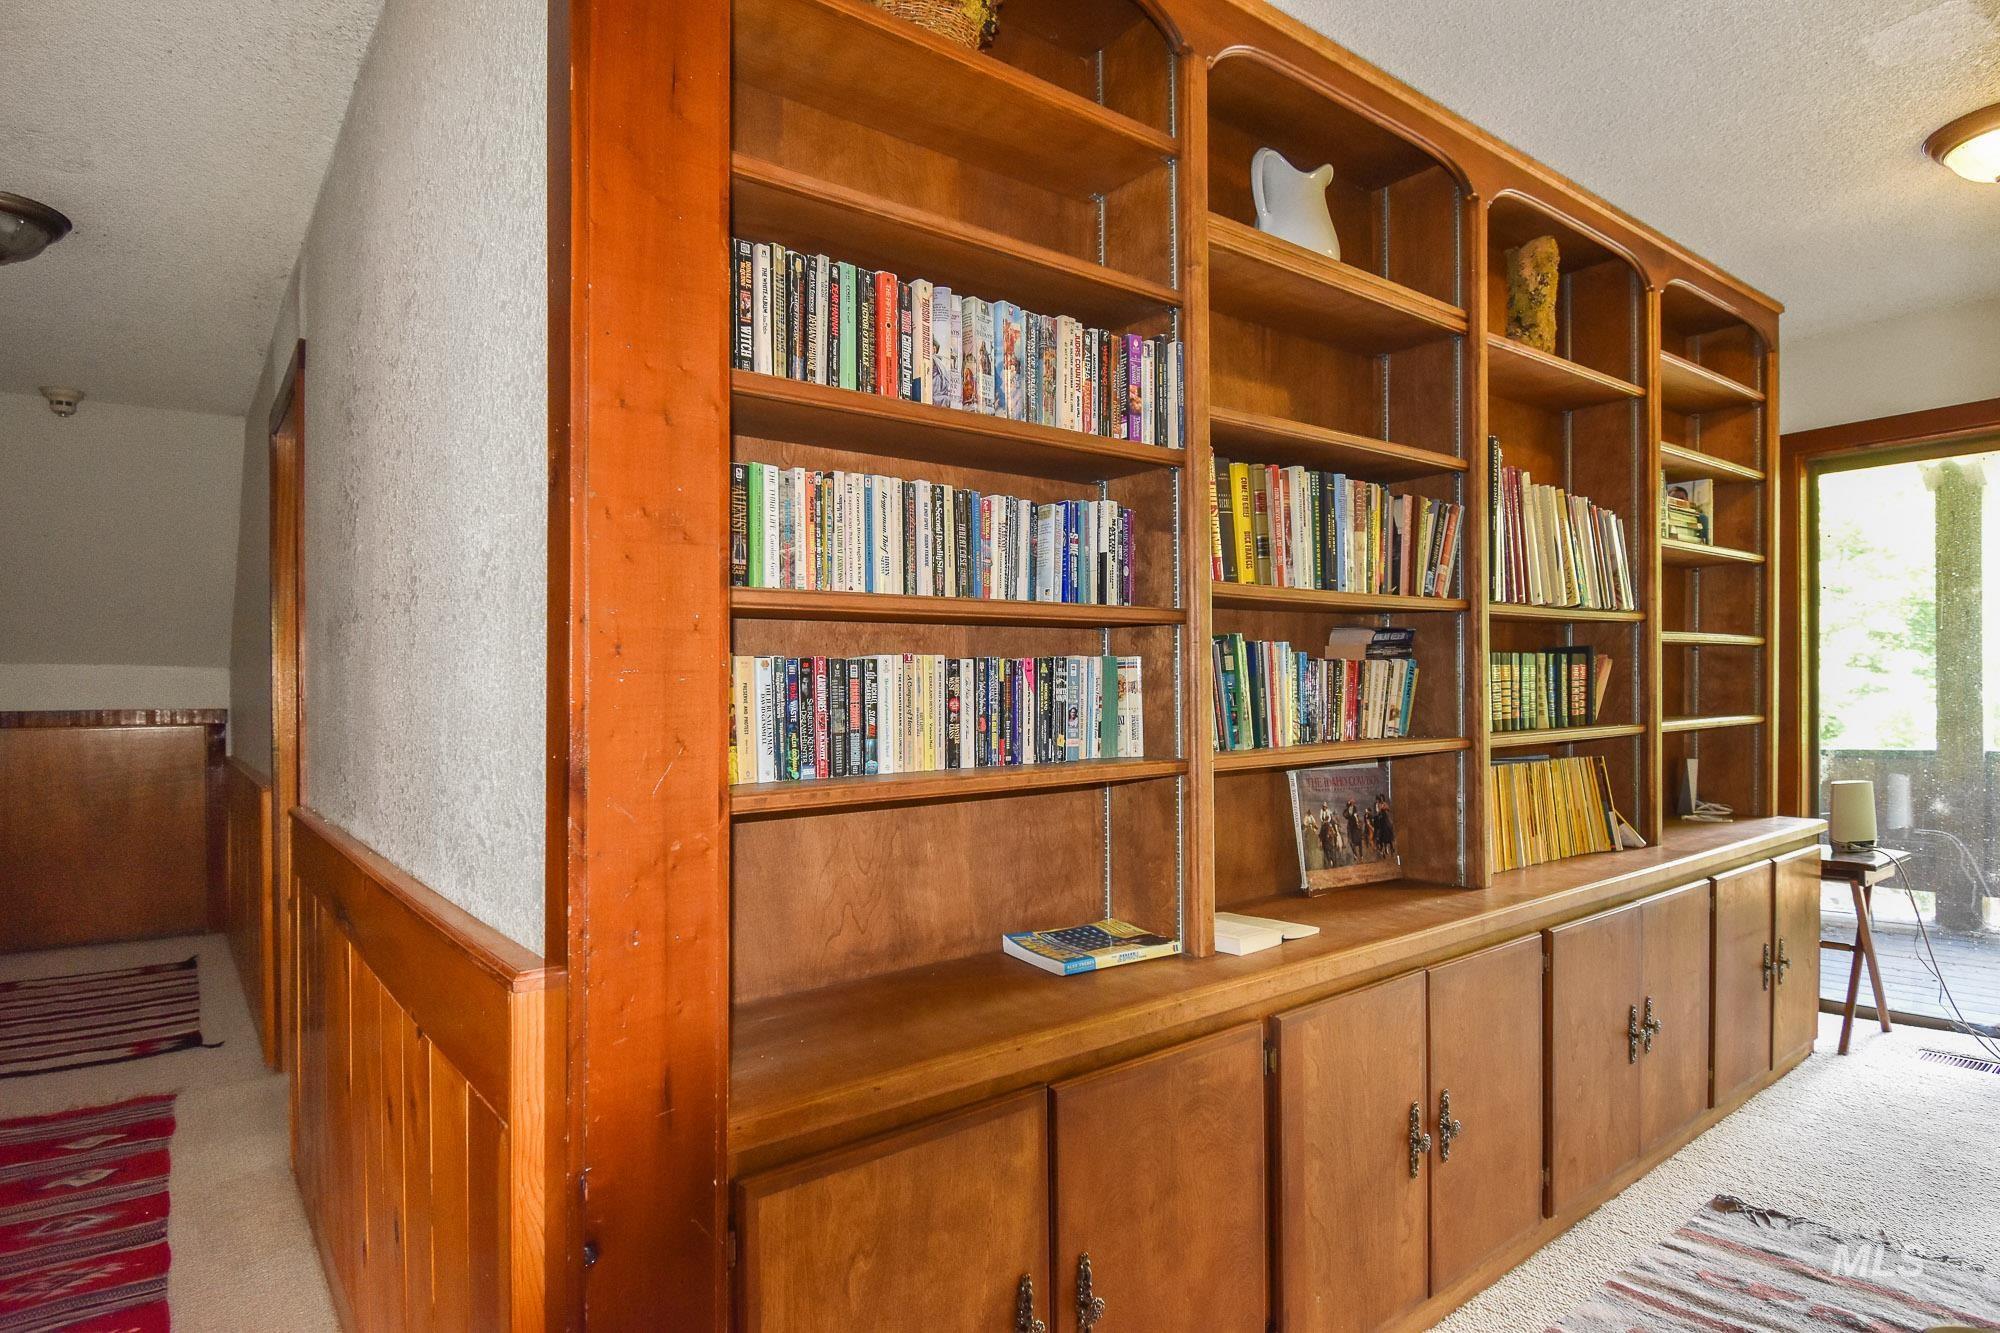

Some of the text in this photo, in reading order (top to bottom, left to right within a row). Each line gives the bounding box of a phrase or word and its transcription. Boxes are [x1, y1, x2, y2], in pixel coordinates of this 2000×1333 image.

[740, 325, 752, 356] WITCH
[902, 334, 912, 366] Clifford
[902, 368, 912, 395] Irving
[935, 534, 944, 560] Deadly
[817, 674, 826, 712] CARNIVORES
